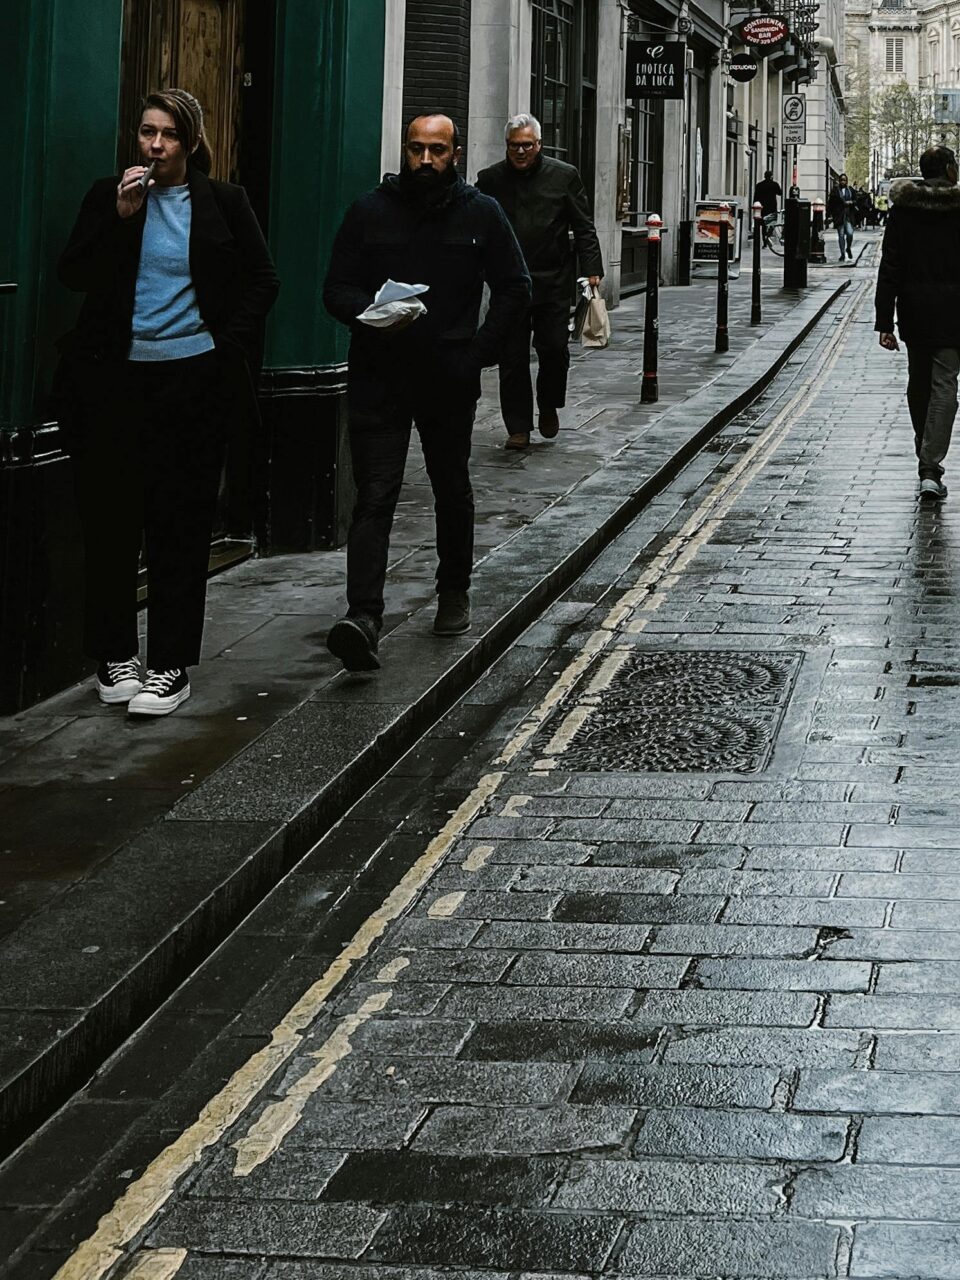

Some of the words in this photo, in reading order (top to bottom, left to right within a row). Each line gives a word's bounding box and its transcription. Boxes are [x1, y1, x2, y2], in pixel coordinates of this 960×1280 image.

[744, 18, 785, 32] CONTINENTAL
[636, 63, 675, 75] ENOTECA
[635, 75, 647, 87] DA
[652, 75, 675, 87] LUCA
